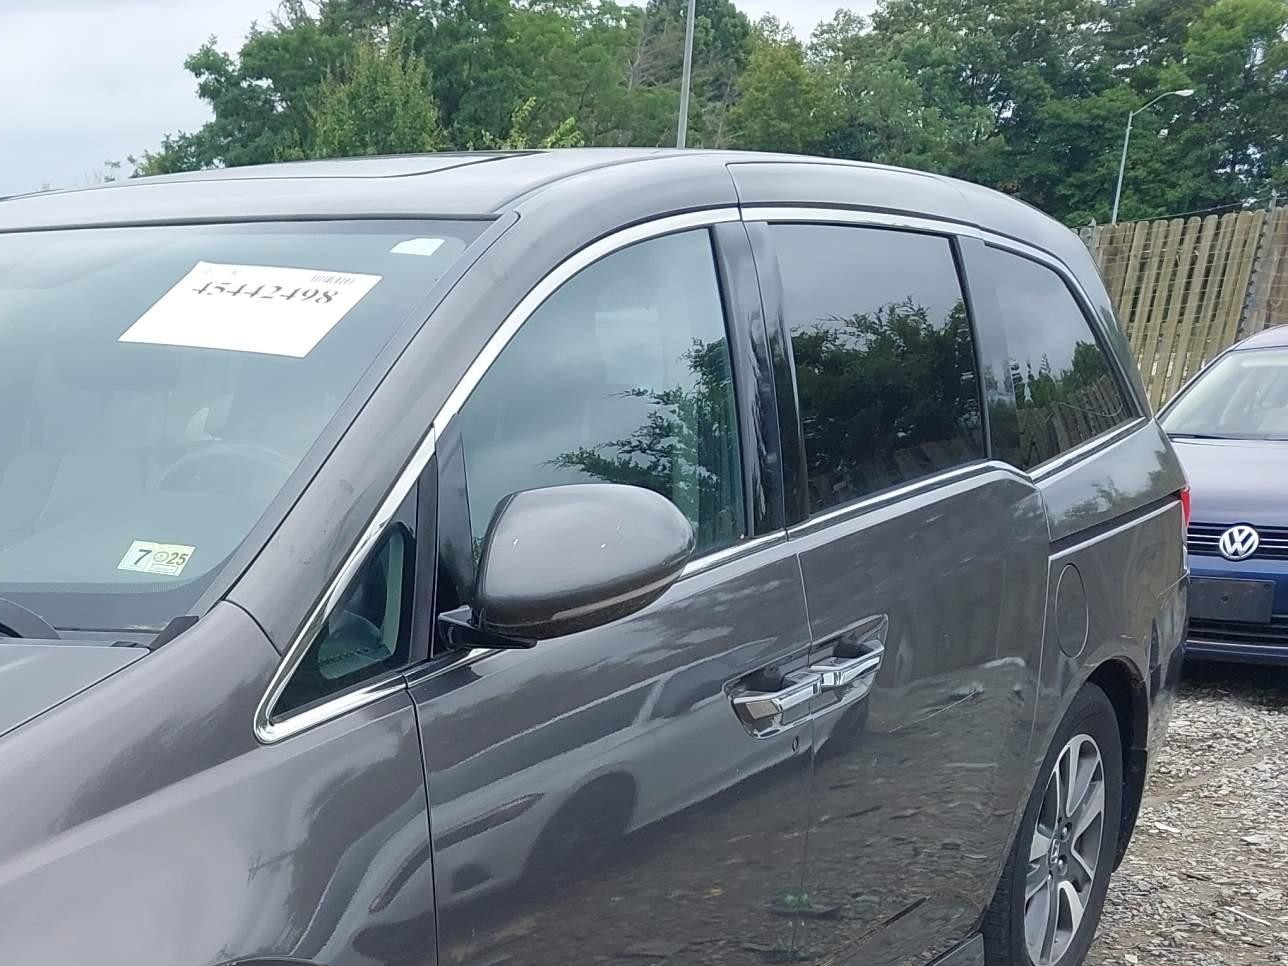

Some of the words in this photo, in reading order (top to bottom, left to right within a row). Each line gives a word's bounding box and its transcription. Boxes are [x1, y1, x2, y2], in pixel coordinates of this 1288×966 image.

[192, 281, 339, 303] 45442498
[134, 548, 153, 566] 7
[166, 551, 189, 566] 25
